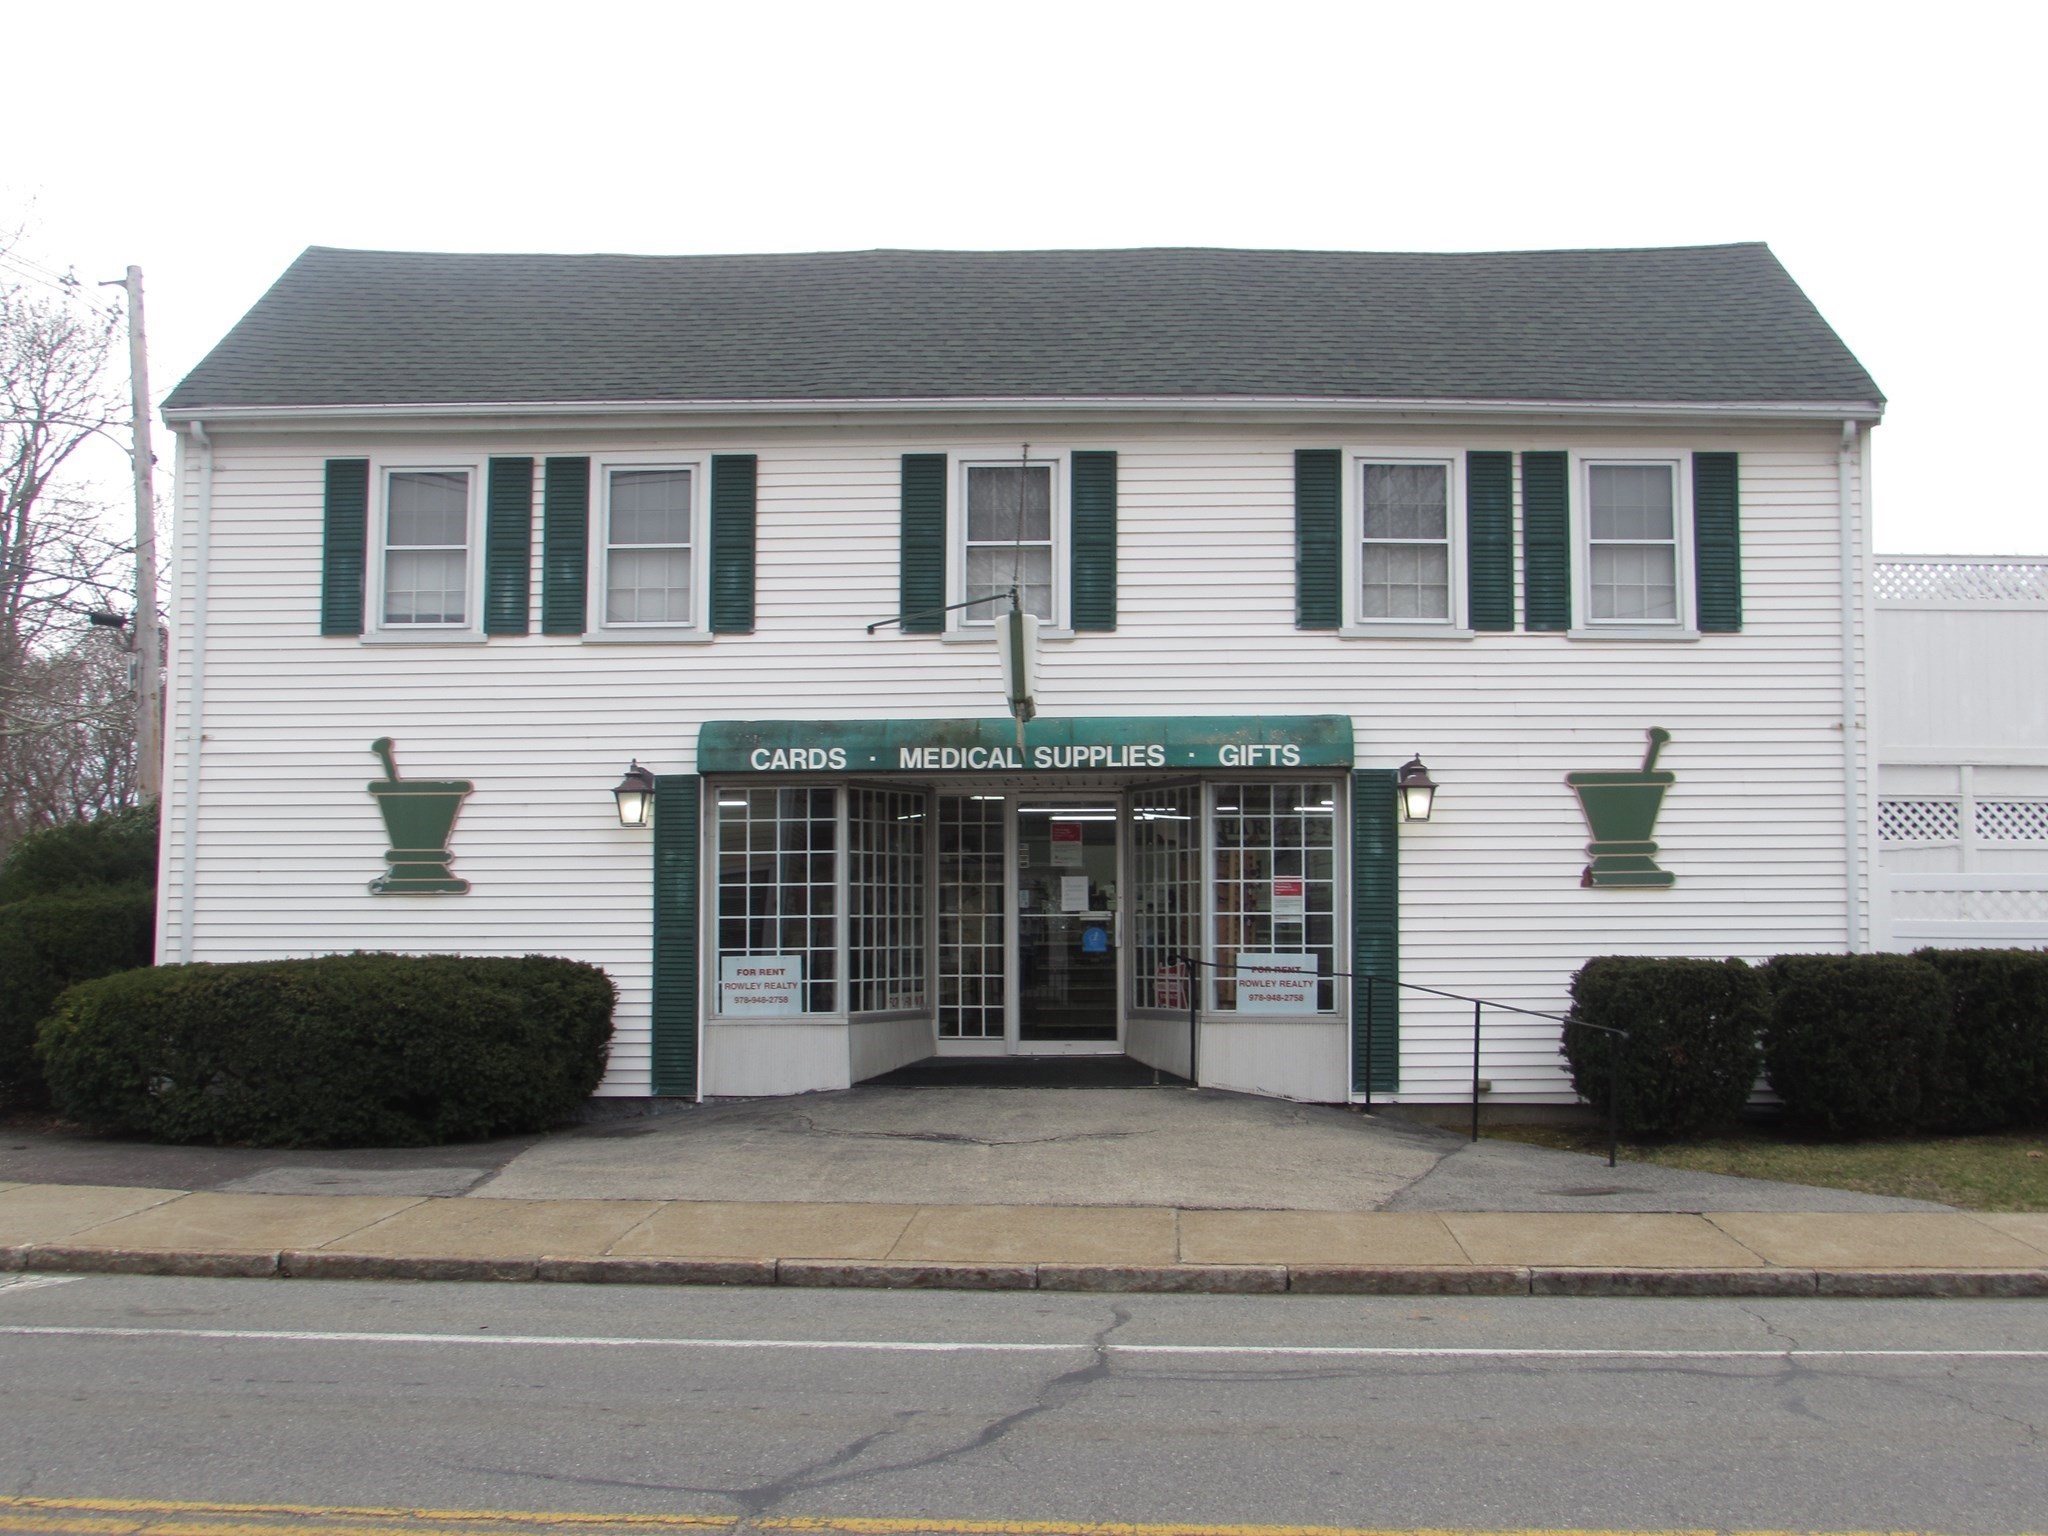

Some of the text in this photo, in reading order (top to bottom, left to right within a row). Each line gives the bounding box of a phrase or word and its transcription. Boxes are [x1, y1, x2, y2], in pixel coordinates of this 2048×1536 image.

[750, 744, 1301, 770] CARDS MEDICAL SUPPLIES GIFTS
[736, 968, 786, 976] FOR RENT
[1251, 965, 1302, 974] FOR RENT
[724, 981, 798, 990] ROWLEY REALTY
[1239, 980, 1314, 988] ROWLEY REALTY
[734, 996, 789, 1004] 978-948-2758
[1248, 994, 1304, 1002] 978-948-2758
